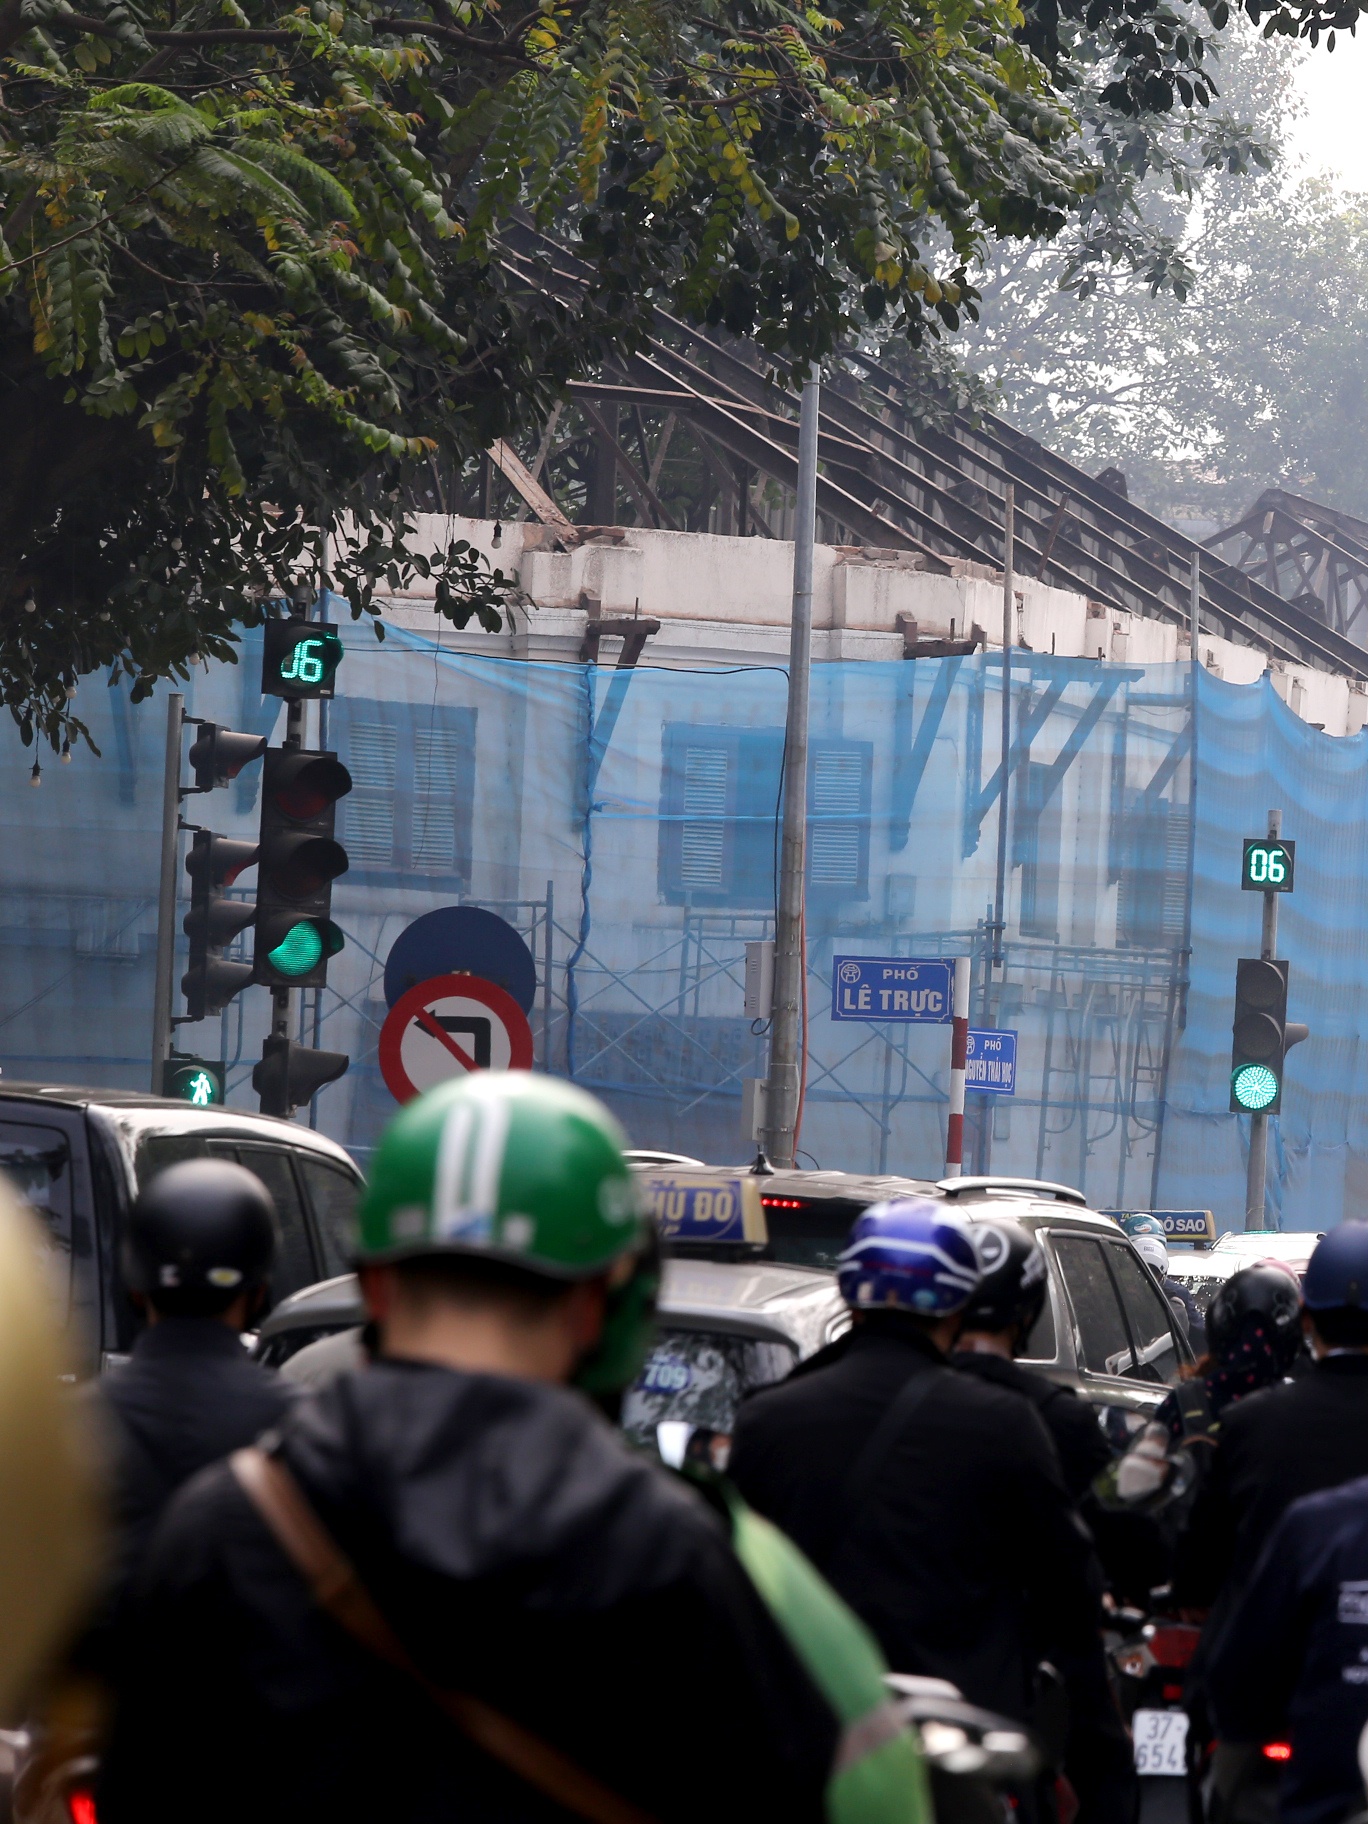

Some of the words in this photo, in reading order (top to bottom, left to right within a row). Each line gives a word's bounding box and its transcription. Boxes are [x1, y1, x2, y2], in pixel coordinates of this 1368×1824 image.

[1250, 849, 1285, 883] 06
[882, 965, 920, 981] PHỐ
[843, 984, 872, 1010] LÊ
[879, 988, 943, 1017] TRỰC
[984, 1036, 1003, 1051] PHỐ
[1175, 1218, 1206, 1232] SAO
